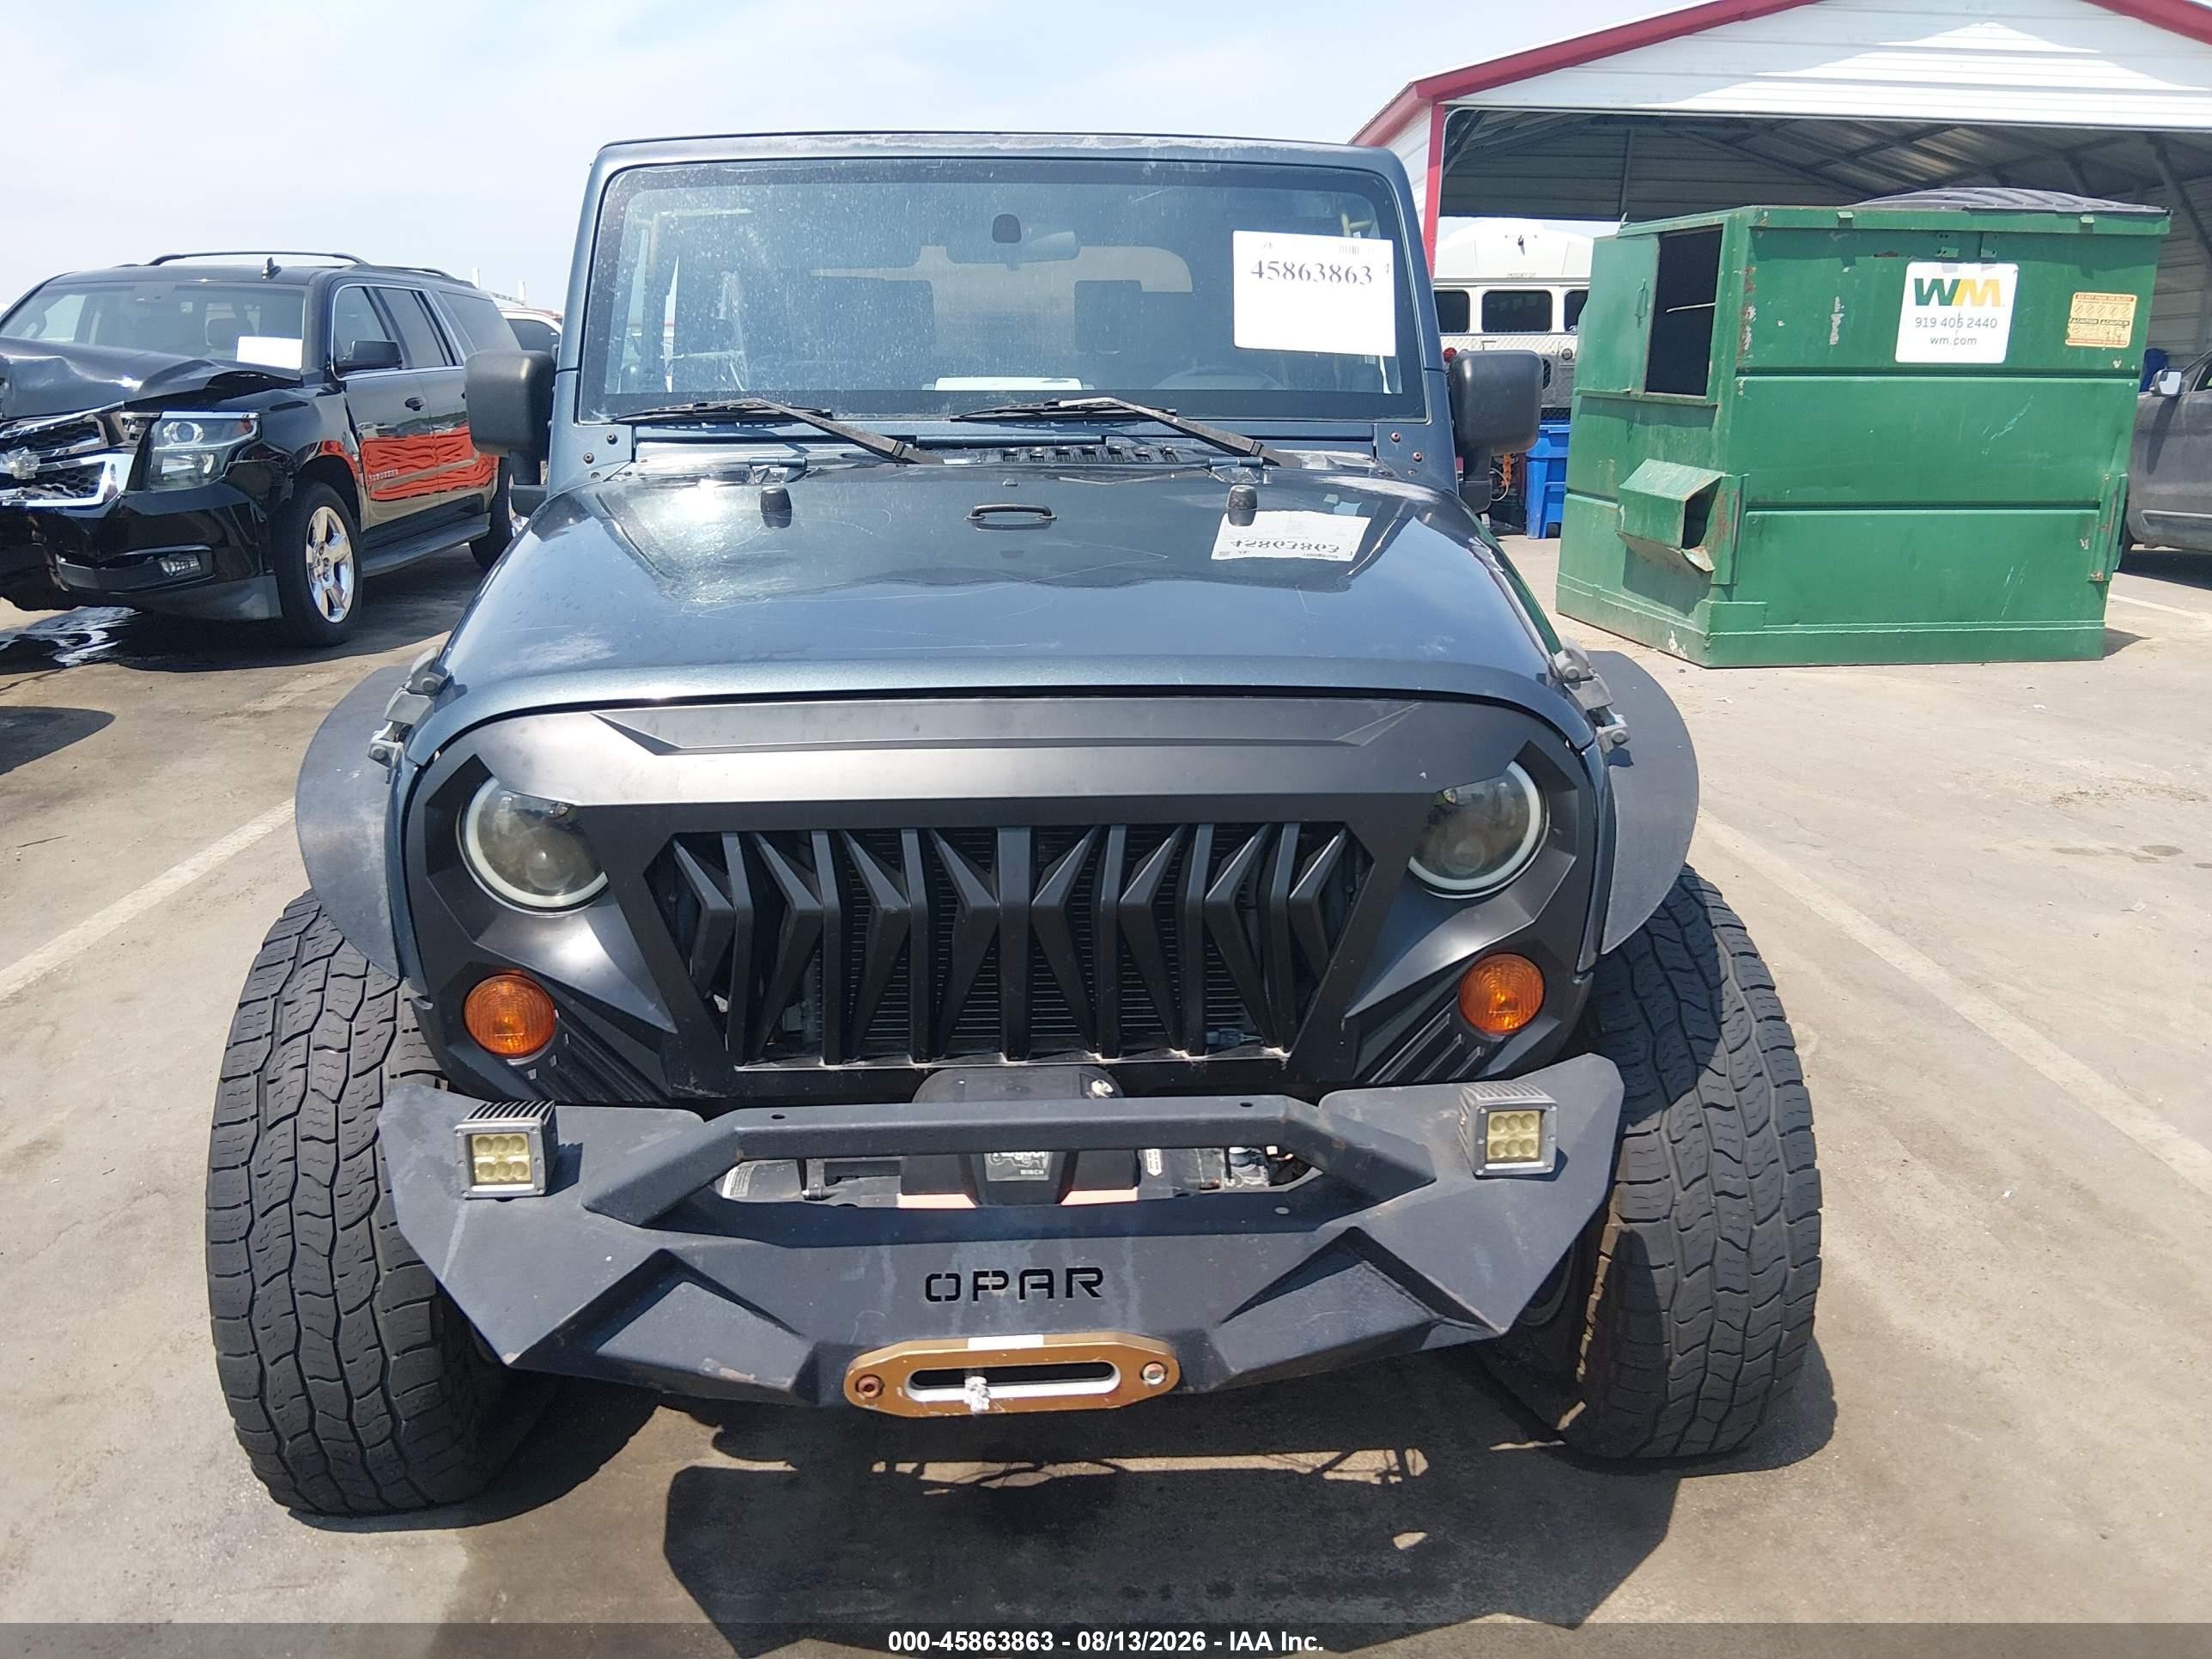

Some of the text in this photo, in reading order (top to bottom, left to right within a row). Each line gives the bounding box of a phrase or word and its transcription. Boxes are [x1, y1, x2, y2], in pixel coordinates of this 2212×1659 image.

[1250, 259, 1373, 286] 45863863
[1914, 277, 2002, 307] WM
[1915, 317, 1937, 328] 919
[1966, 318, 1998, 329] 2440
[1929, 337, 1977, 346] wm.com
[926, 1267, 1103, 1303] OPAR
